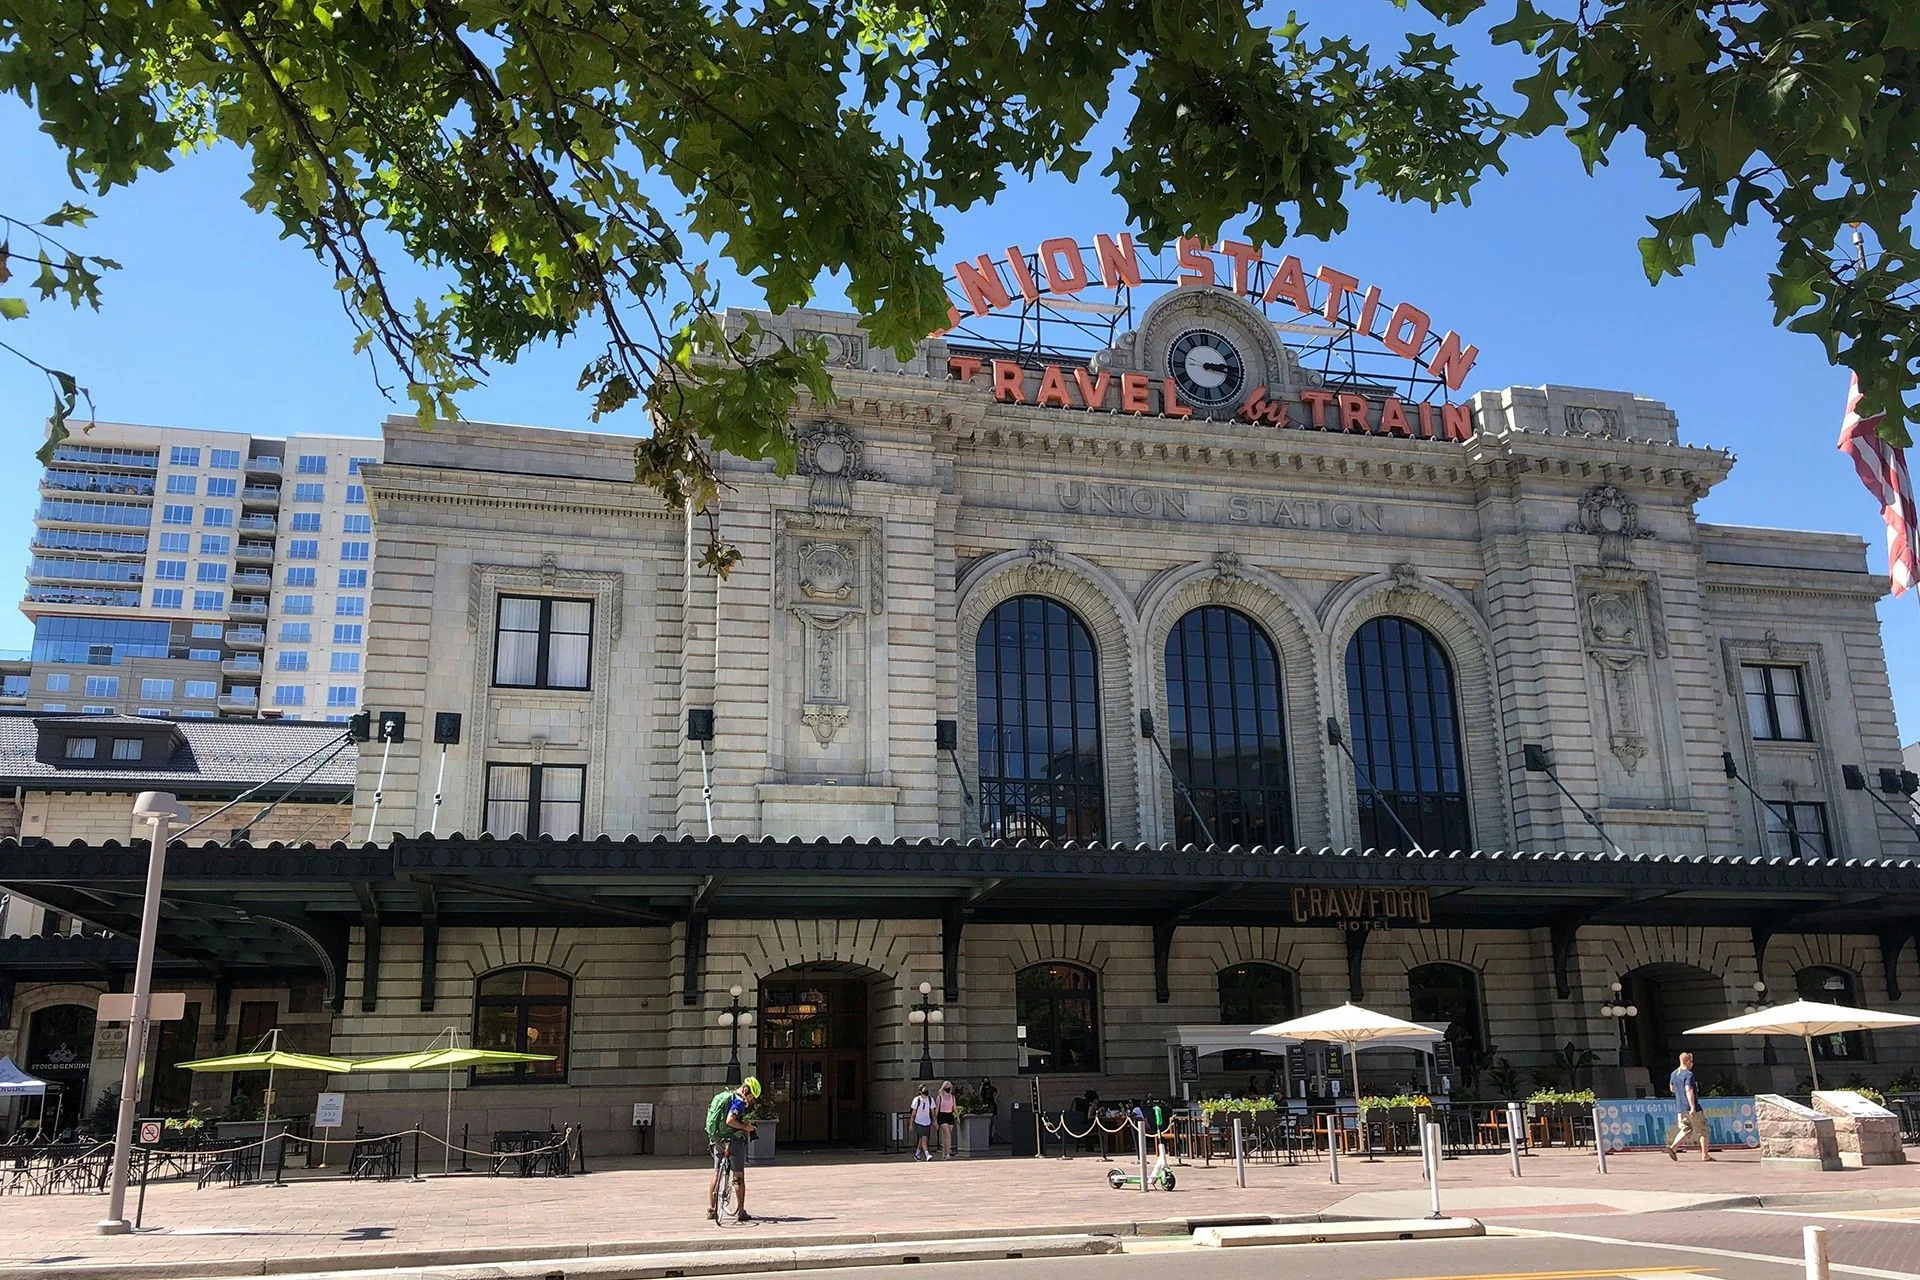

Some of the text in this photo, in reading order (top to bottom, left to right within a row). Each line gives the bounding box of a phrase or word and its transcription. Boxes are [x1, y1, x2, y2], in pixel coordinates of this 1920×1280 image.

[1175, 235, 1479, 391] STATION
[947, 355, 1472, 441] TRAVEL by TRAIN
[1055, 481, 1384, 531] UNION STATION
[1291, 887, 1430, 923] CRAWFORD
[1338, 921, 1393, 931] HOTEL
[1646, 1103, 1662, 1113] GOT
[1663, 1103, 1676, 1113] THI
